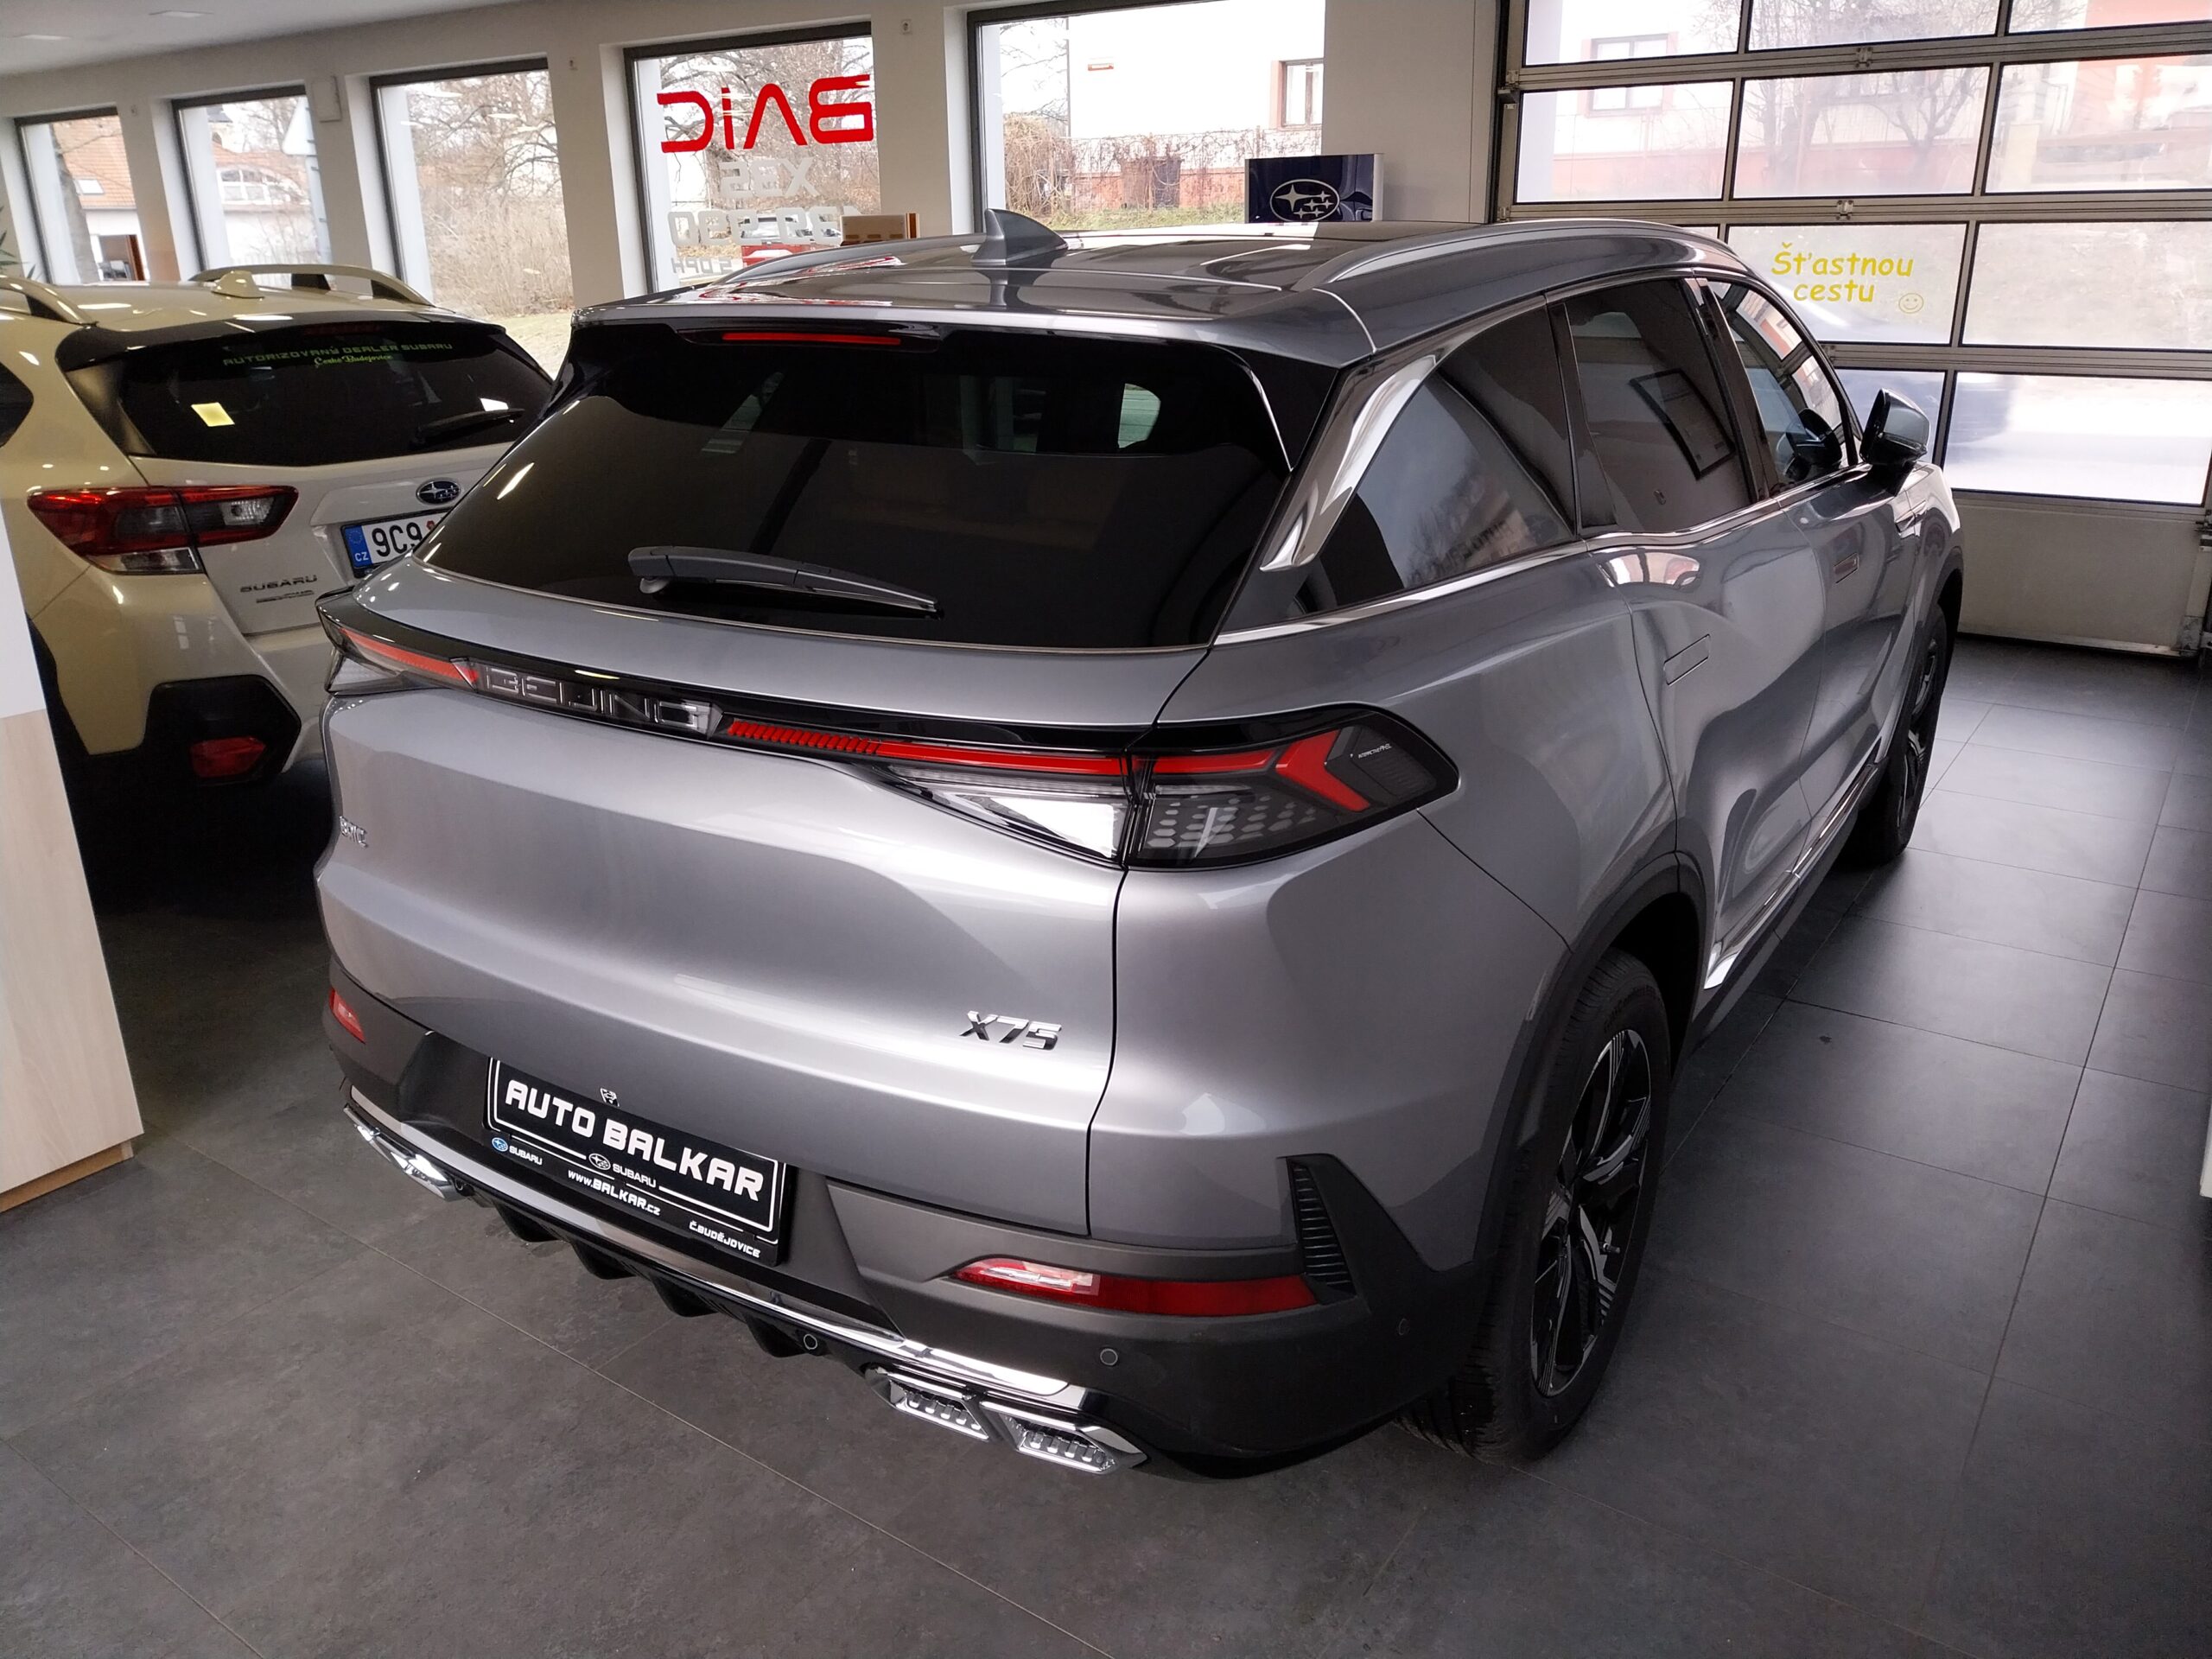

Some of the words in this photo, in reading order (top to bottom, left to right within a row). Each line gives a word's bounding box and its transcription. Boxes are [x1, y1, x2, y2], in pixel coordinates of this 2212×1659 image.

[1793, 279, 1875, 302] cestu
[342, 344, 399, 355] DEALER
[401, 342, 454, 352] SUBARU
[354, 551, 370, 563] CZ
[239, 574, 318, 593] SUBARU
[486, 666, 698, 729] BEIJING
[959, 1009, 1062, 1051] X75
[505, 1079, 595, 1138] AUTO
[602, 1118, 764, 1202] BALKAR
[508, 1145, 543, 1166] SUBARU
[612, 1163, 657, 1188] SUBARU
